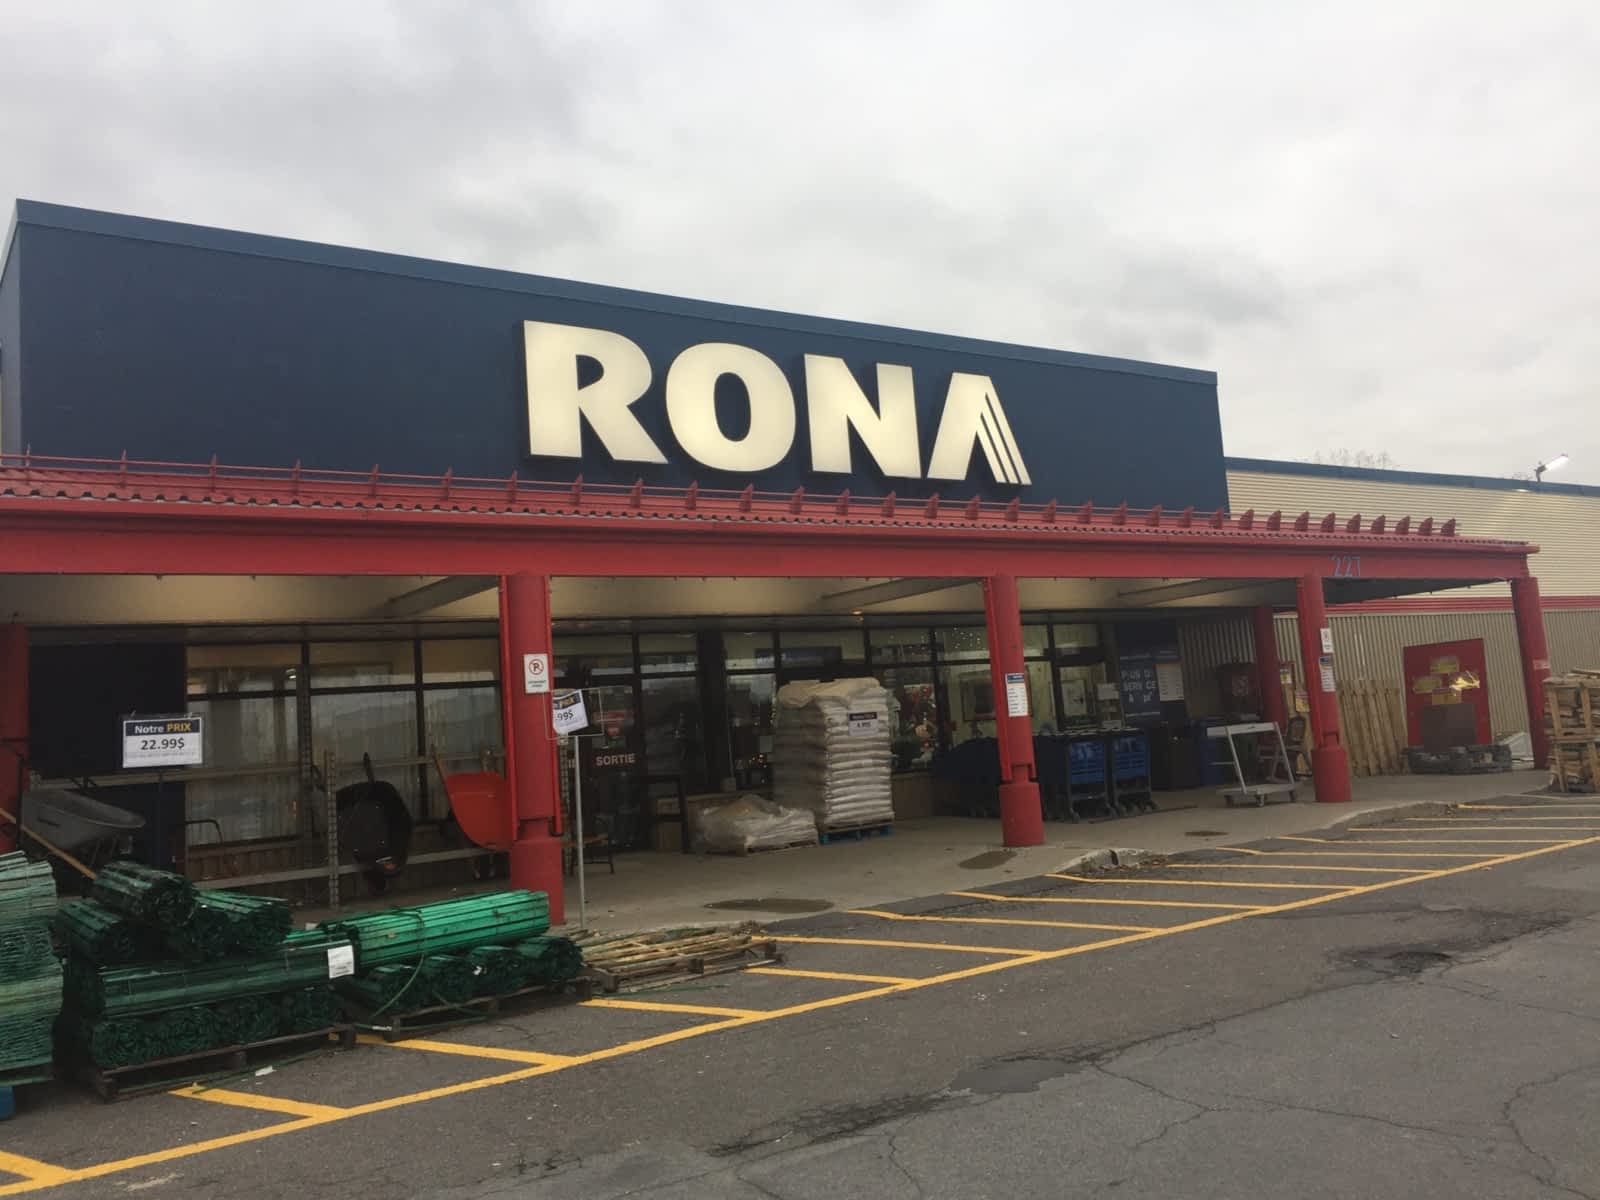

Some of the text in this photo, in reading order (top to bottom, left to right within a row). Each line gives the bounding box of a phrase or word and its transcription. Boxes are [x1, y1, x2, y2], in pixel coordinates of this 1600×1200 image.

[523, 319, 1032, 486] RONA
[135, 723, 192, 734] Notre PRIX
[141, 737, 185, 750] 22.99$
[596, 754, 636, 766] SORTIE
